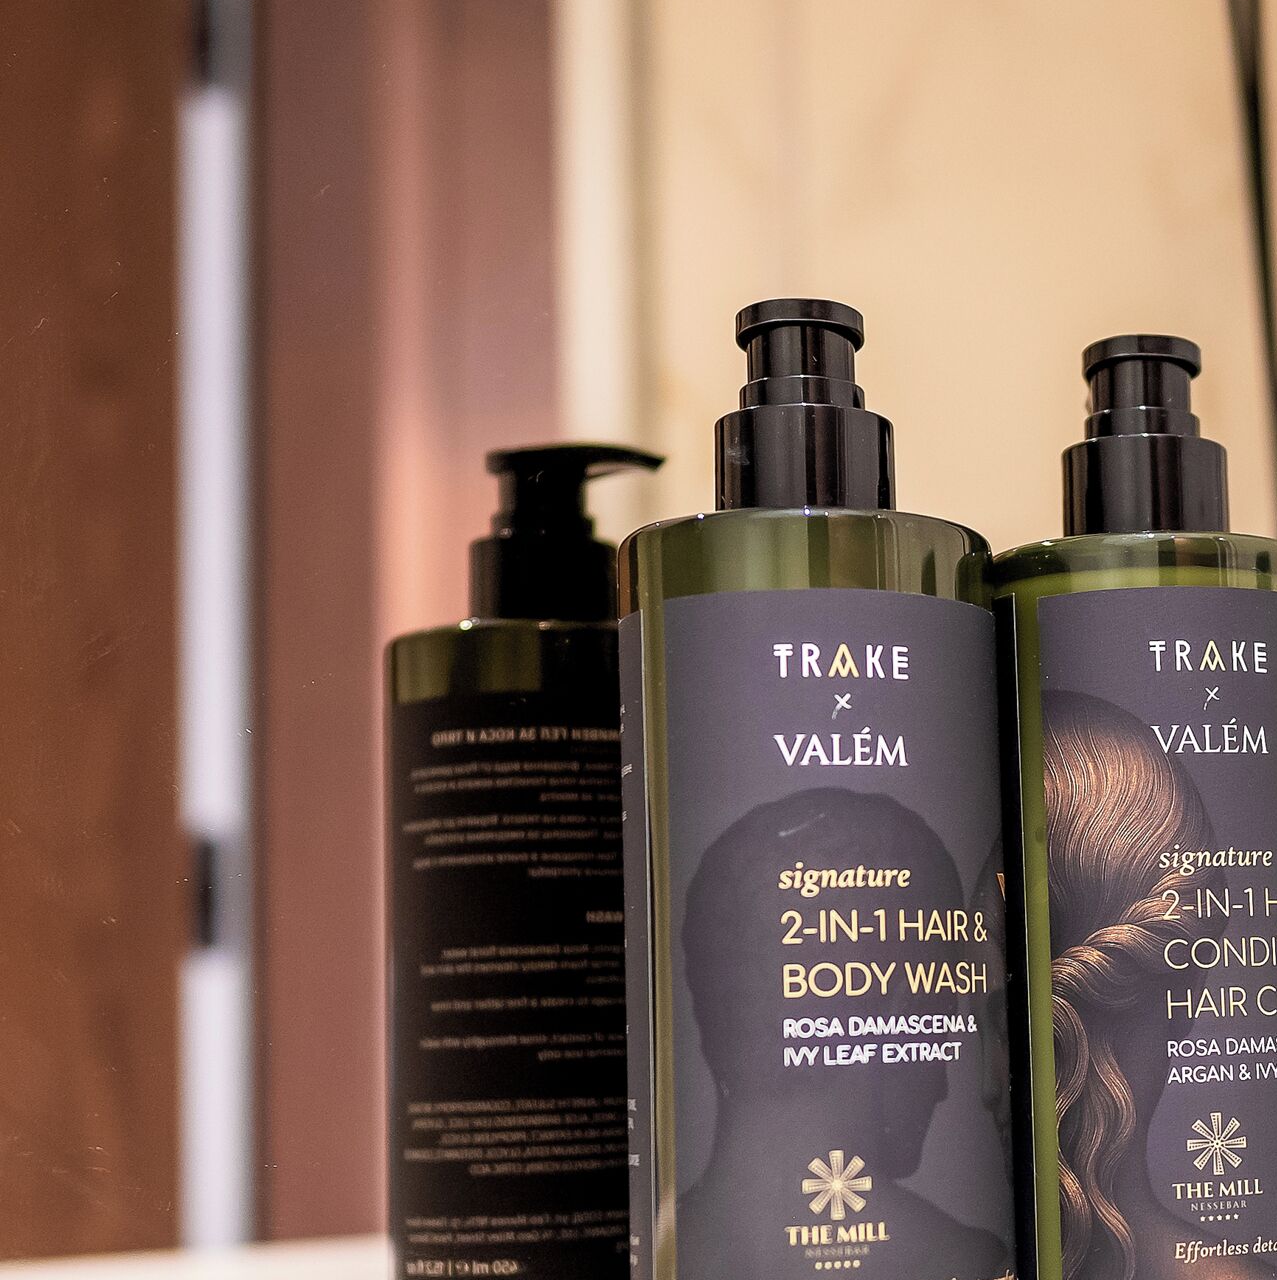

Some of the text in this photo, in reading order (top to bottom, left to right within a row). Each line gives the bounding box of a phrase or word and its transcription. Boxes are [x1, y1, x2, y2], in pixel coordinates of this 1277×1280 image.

[774, 644, 908, 679] TRAKE
[1149, 640, 1267, 673] TRAKE
[773, 727, 908, 766] VALÉM
[1150, 718, 1268, 753] VALÉM
[1159, 845, 1272, 875] signature
[779, 862, 910, 897] signature
[1161, 888, 1253, 919] 2-IN-1
[781, 909, 987, 944] 2-IN-1 HAIR &
[783, 962, 986, 998] BODY WASH
[1168, 987, 1247, 1019] HAIR
[784, 1018, 844, 1038] ROSA
[784, 1042, 962, 1066] IVY LEAF EXTRACT
[1168, 1039, 1221, 1057] ROSA
[1168, 1065, 1233, 1083] ARGAN
[1239, 1064, 1251, 1080] &
[1172, 1179, 1263, 1199] THE MILL
[785, 1222, 890, 1245] THE MILL
[1175, 1240, 1248, 1263] Effortless
